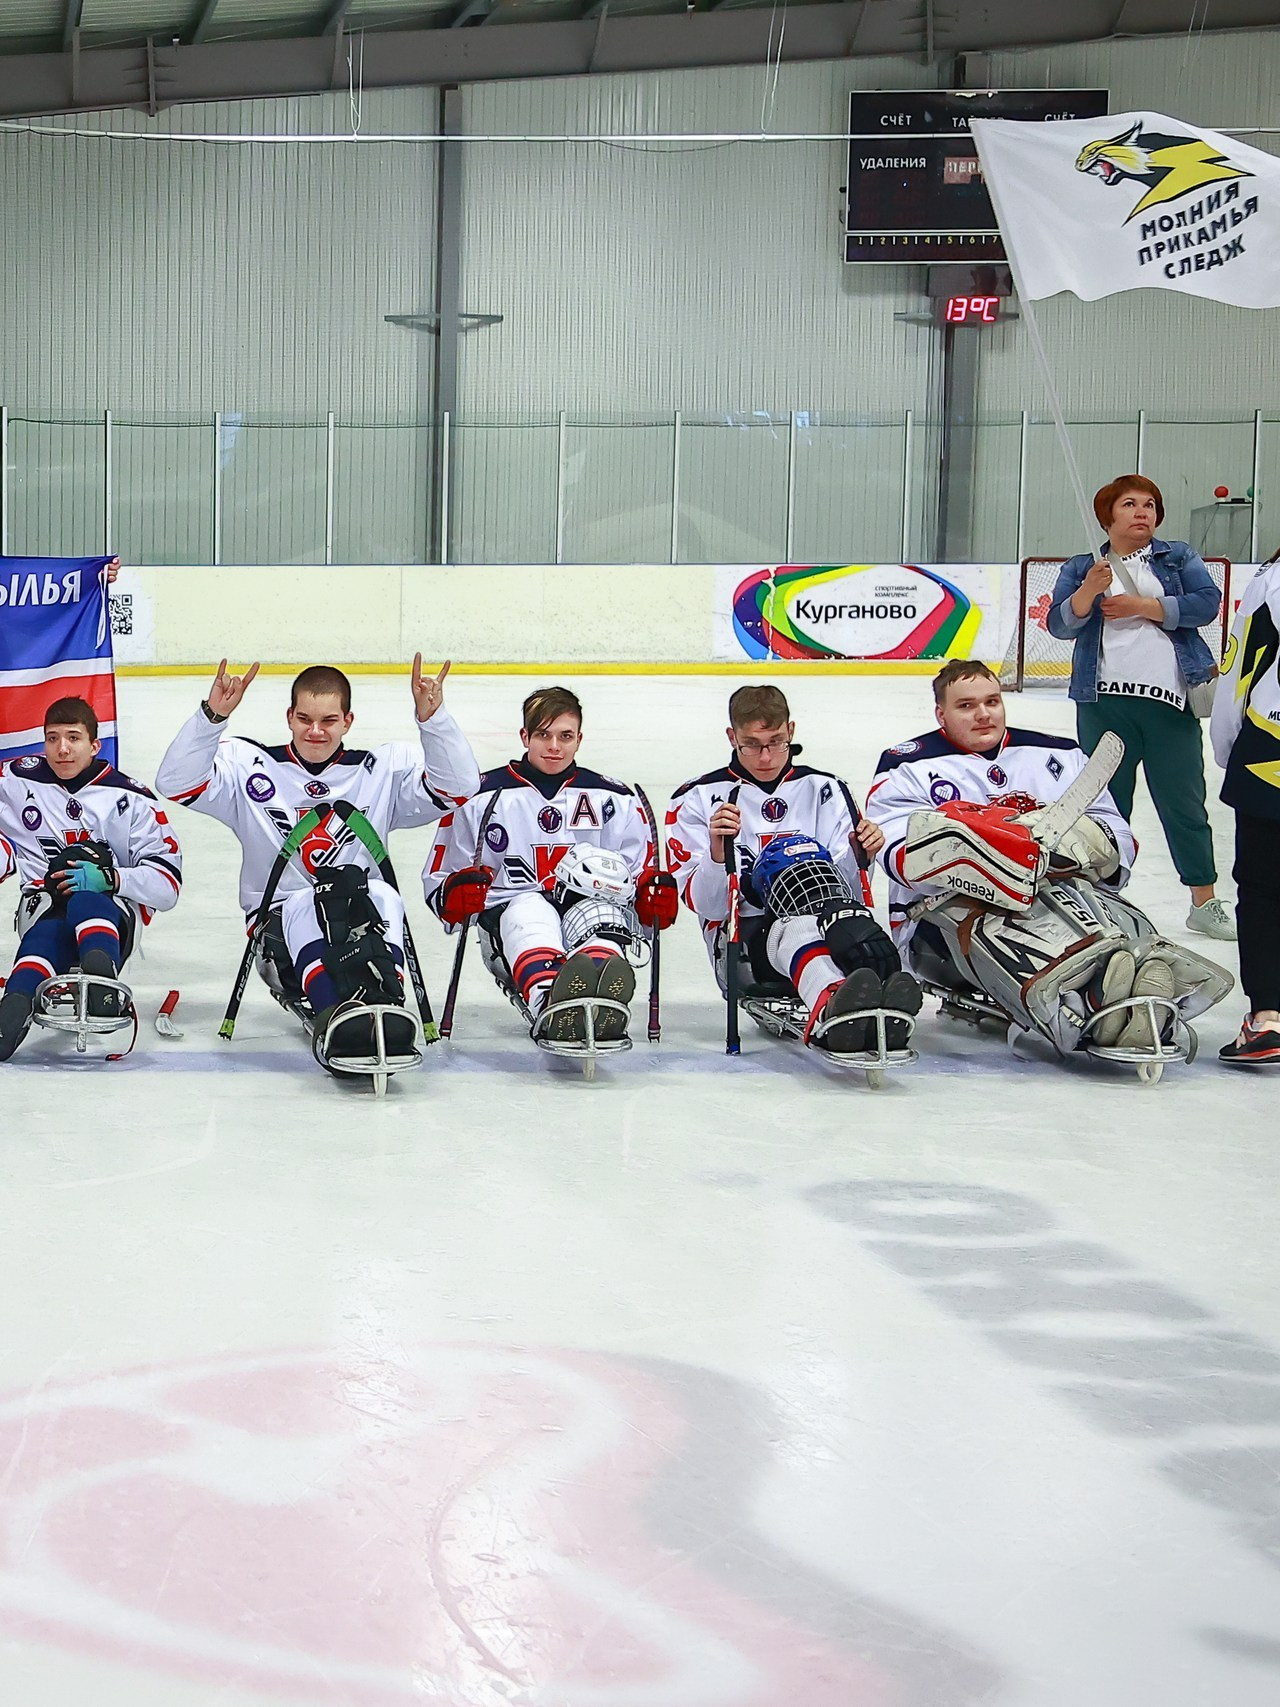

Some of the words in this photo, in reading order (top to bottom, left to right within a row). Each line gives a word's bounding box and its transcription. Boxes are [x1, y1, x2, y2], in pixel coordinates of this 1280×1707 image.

[880, 112, 912, 126] СЧЁТ
[859, 157, 927, 170] УДАЛЕНИЯ
[1140, 181, 1240, 241] МОЛНИЯ
[857, 236, 863, 245] 1
[880, 236, 886, 245] 2
[902, 236, 908, 245] 3
[924, 236, 931, 245] 4
[947, 236, 953, 245] 5
[969, 236, 976, 245] 6
[992, 236, 998, 245] 7
[1137, 195, 1259, 266] ПРИКАМЬЯ
[1164, 233, 1246, 279] СЛЕДЖ
[796, 599, 917, 624] Курганово
[1096, 680, 1183, 709] CANTONE
[569, 791, 600, 827] A
[946, 874, 996, 902] Reebok
[1050, 890, 1098, 927] EFSI
